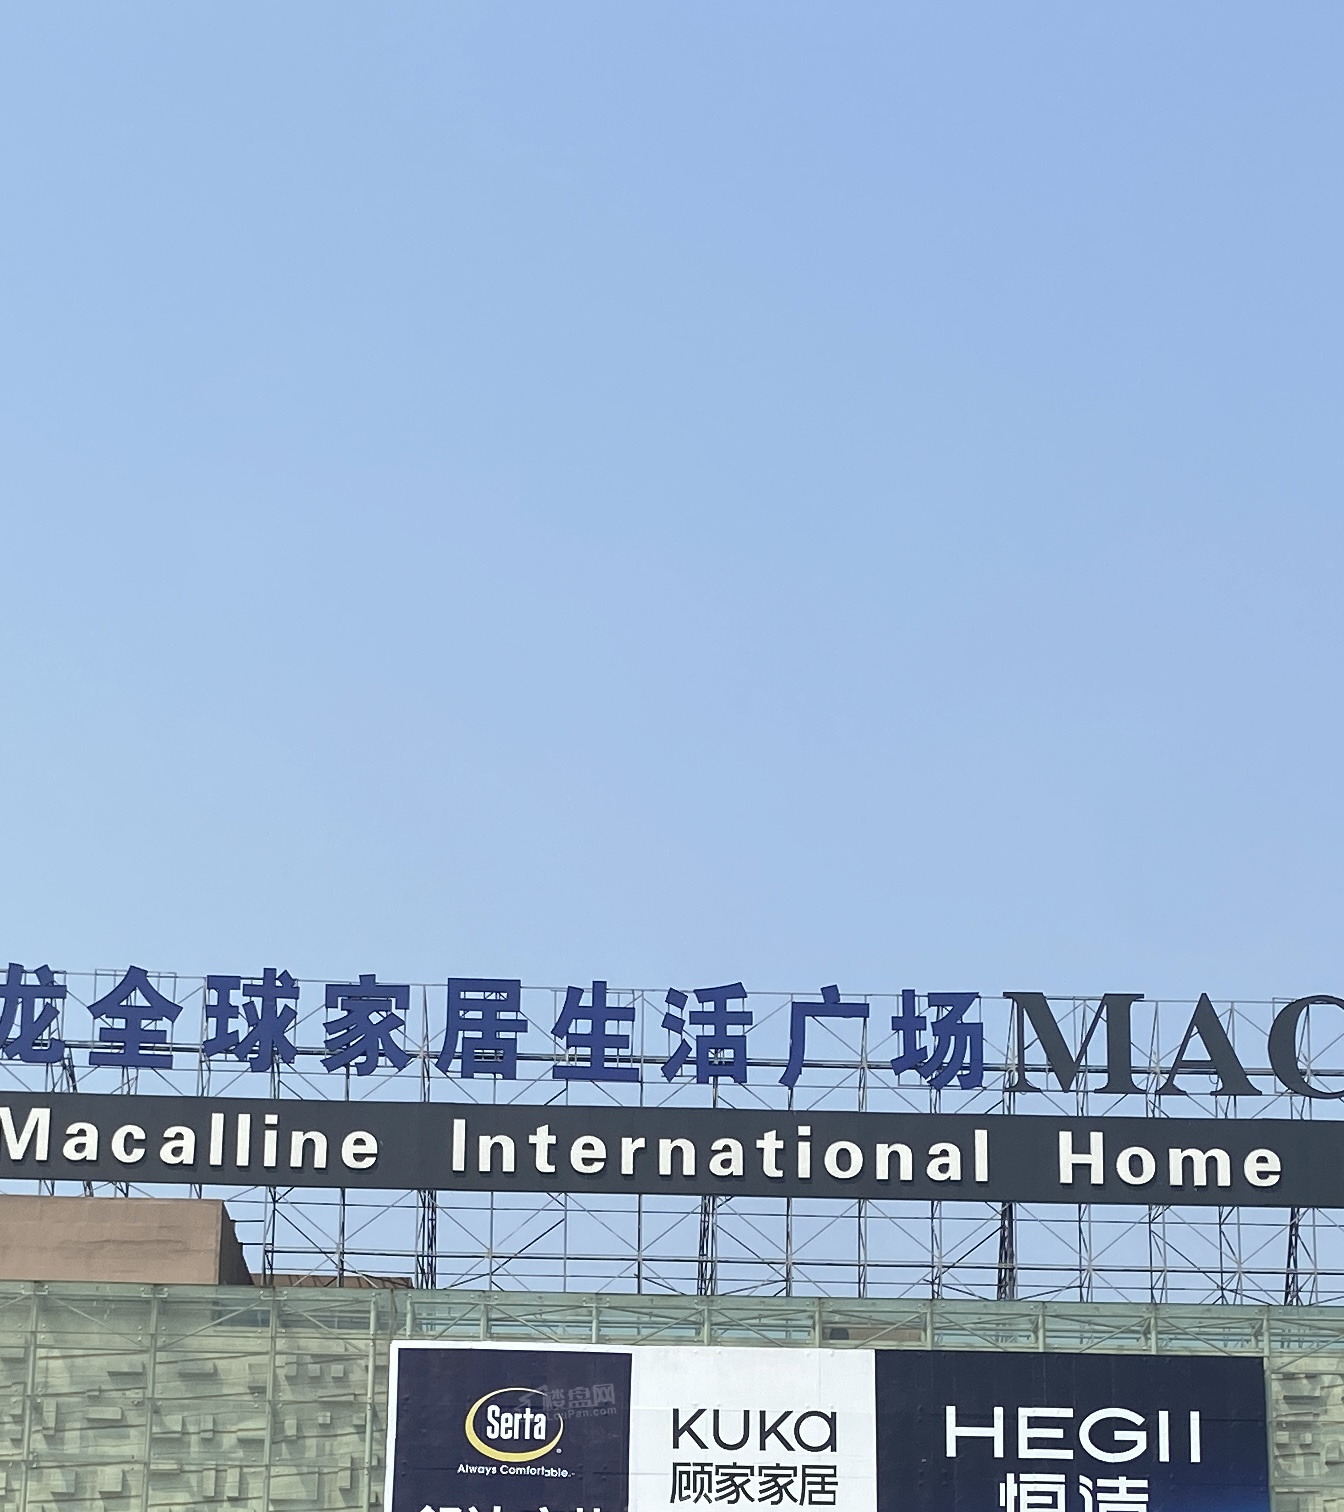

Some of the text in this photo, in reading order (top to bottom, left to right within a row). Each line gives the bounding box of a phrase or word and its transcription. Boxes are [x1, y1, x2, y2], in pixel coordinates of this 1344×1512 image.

[451, 1117, 990, 1184] International
[1058, 1129, 1283, 1188] Home
[486, 1404, 547, 1440] Serta
[946, 1405, 1202, 1463] HEGII
[457, 1463, 497, 1476] Always
[669, 1461, 839, 1506] 顾家家居
